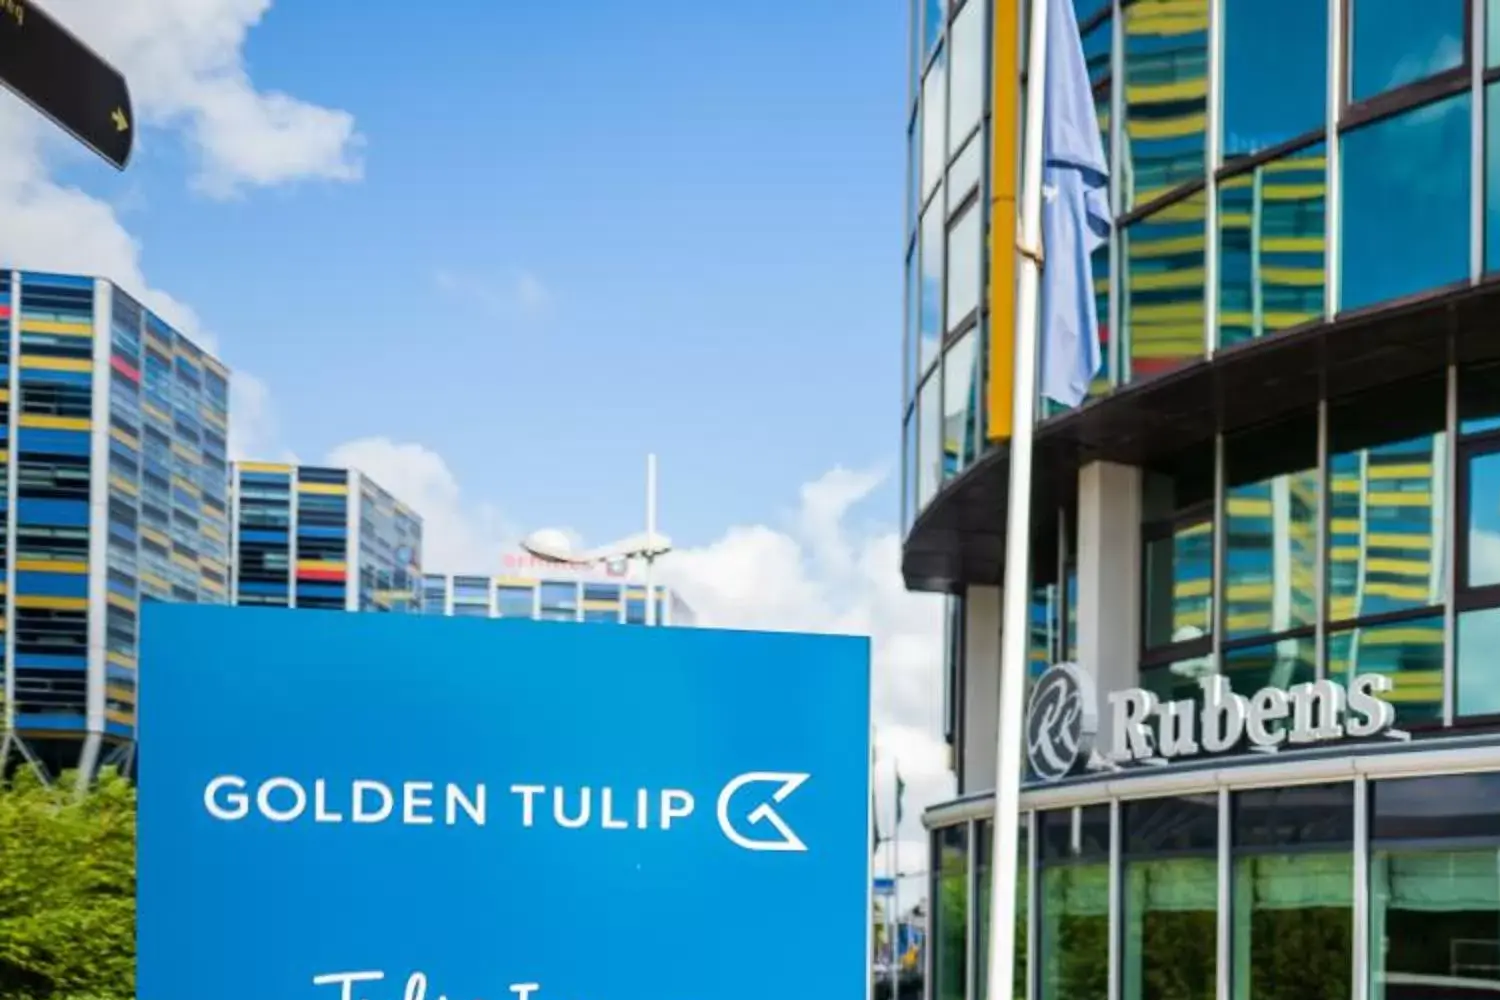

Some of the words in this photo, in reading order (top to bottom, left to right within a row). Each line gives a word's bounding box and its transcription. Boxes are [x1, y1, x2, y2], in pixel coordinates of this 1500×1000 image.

[1107, 673, 1396, 760] Rubens
[203, 775, 486, 826] GOLDEN
[510, 784, 695, 830] TULIP
